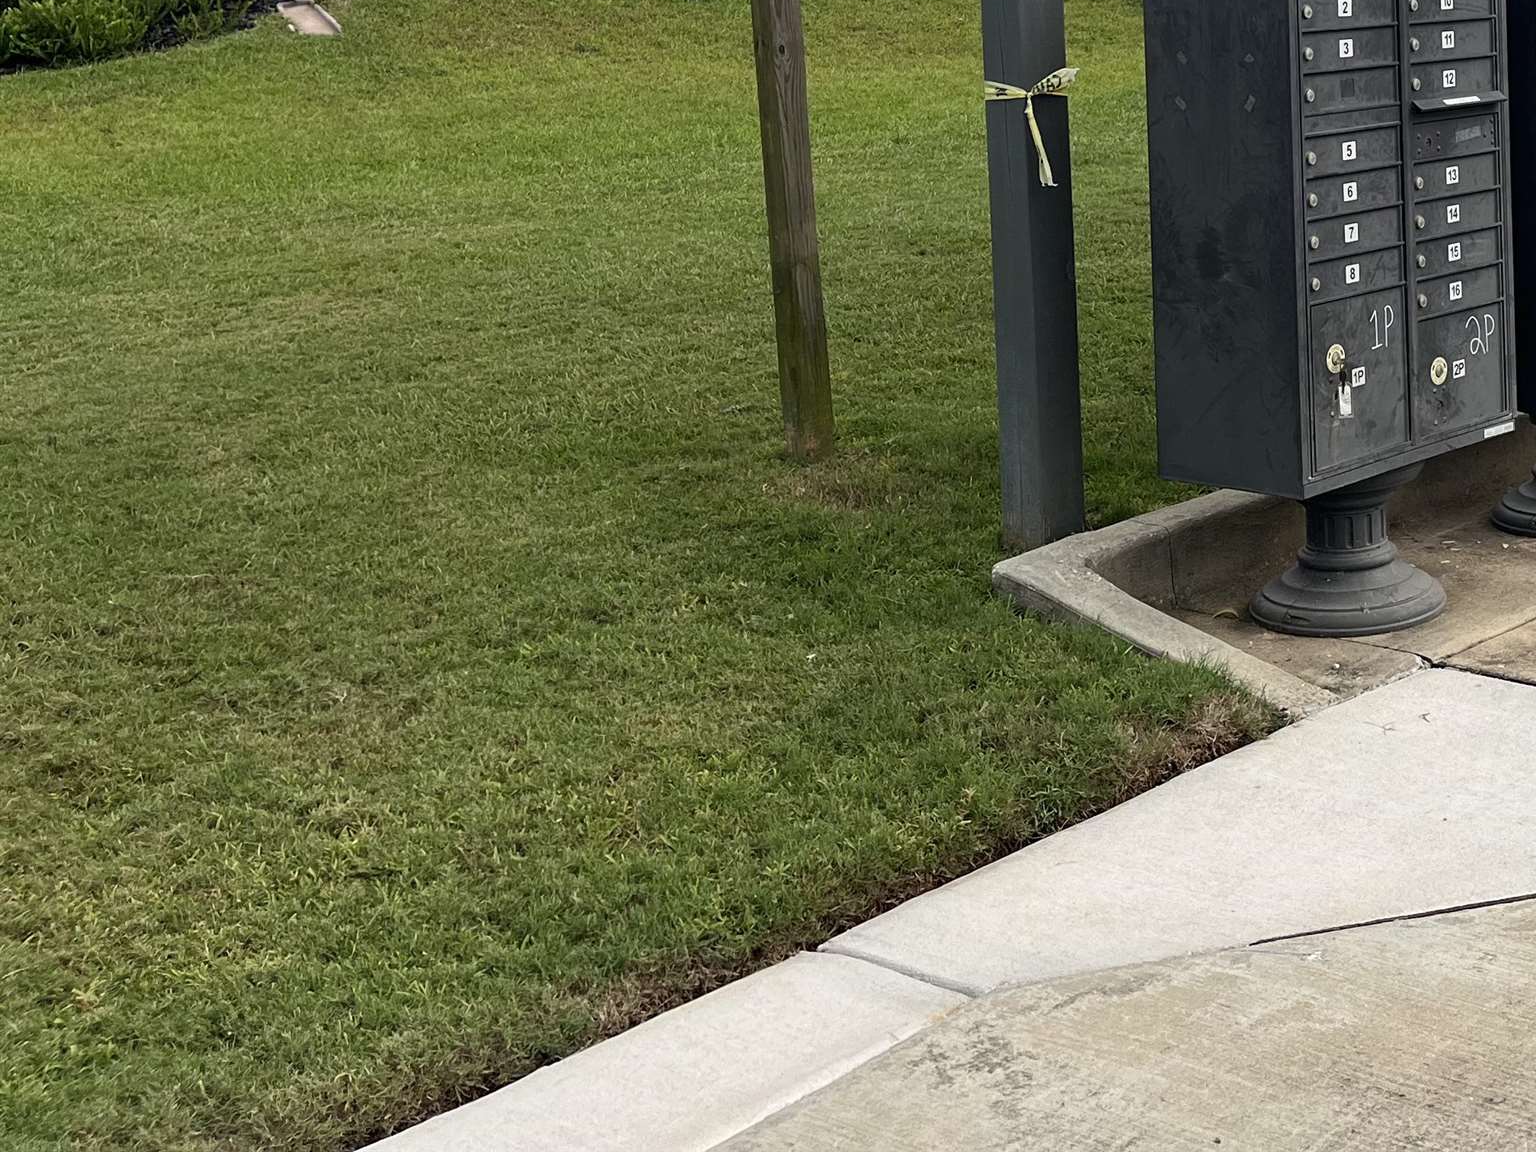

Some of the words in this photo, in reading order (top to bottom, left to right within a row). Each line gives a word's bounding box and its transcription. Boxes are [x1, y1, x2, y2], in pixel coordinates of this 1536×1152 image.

[1342, 0, 1349, 14] 2
[1444, 33, 1453, 46] 11
[1343, 41, 1350, 55] 3
[1444, 72, 1454, 85] 12
[1346, 144, 1353, 158] 5
[1447, 168, 1458, 182] 13
[1347, 185, 1354, 199] 6
[1448, 207, 1459, 220] 14
[1348, 226, 1355, 240] 7
[1449, 245, 1459, 258] 15
[1349, 266, 1356, 281] 8
[1451, 283, 1461, 297] 16
[1369, 304, 1395, 351] 1P
[1465, 313, 1496, 356] 2P
[1454, 361, 1465, 377] 2P
[1353, 369, 1364, 384] 1P
